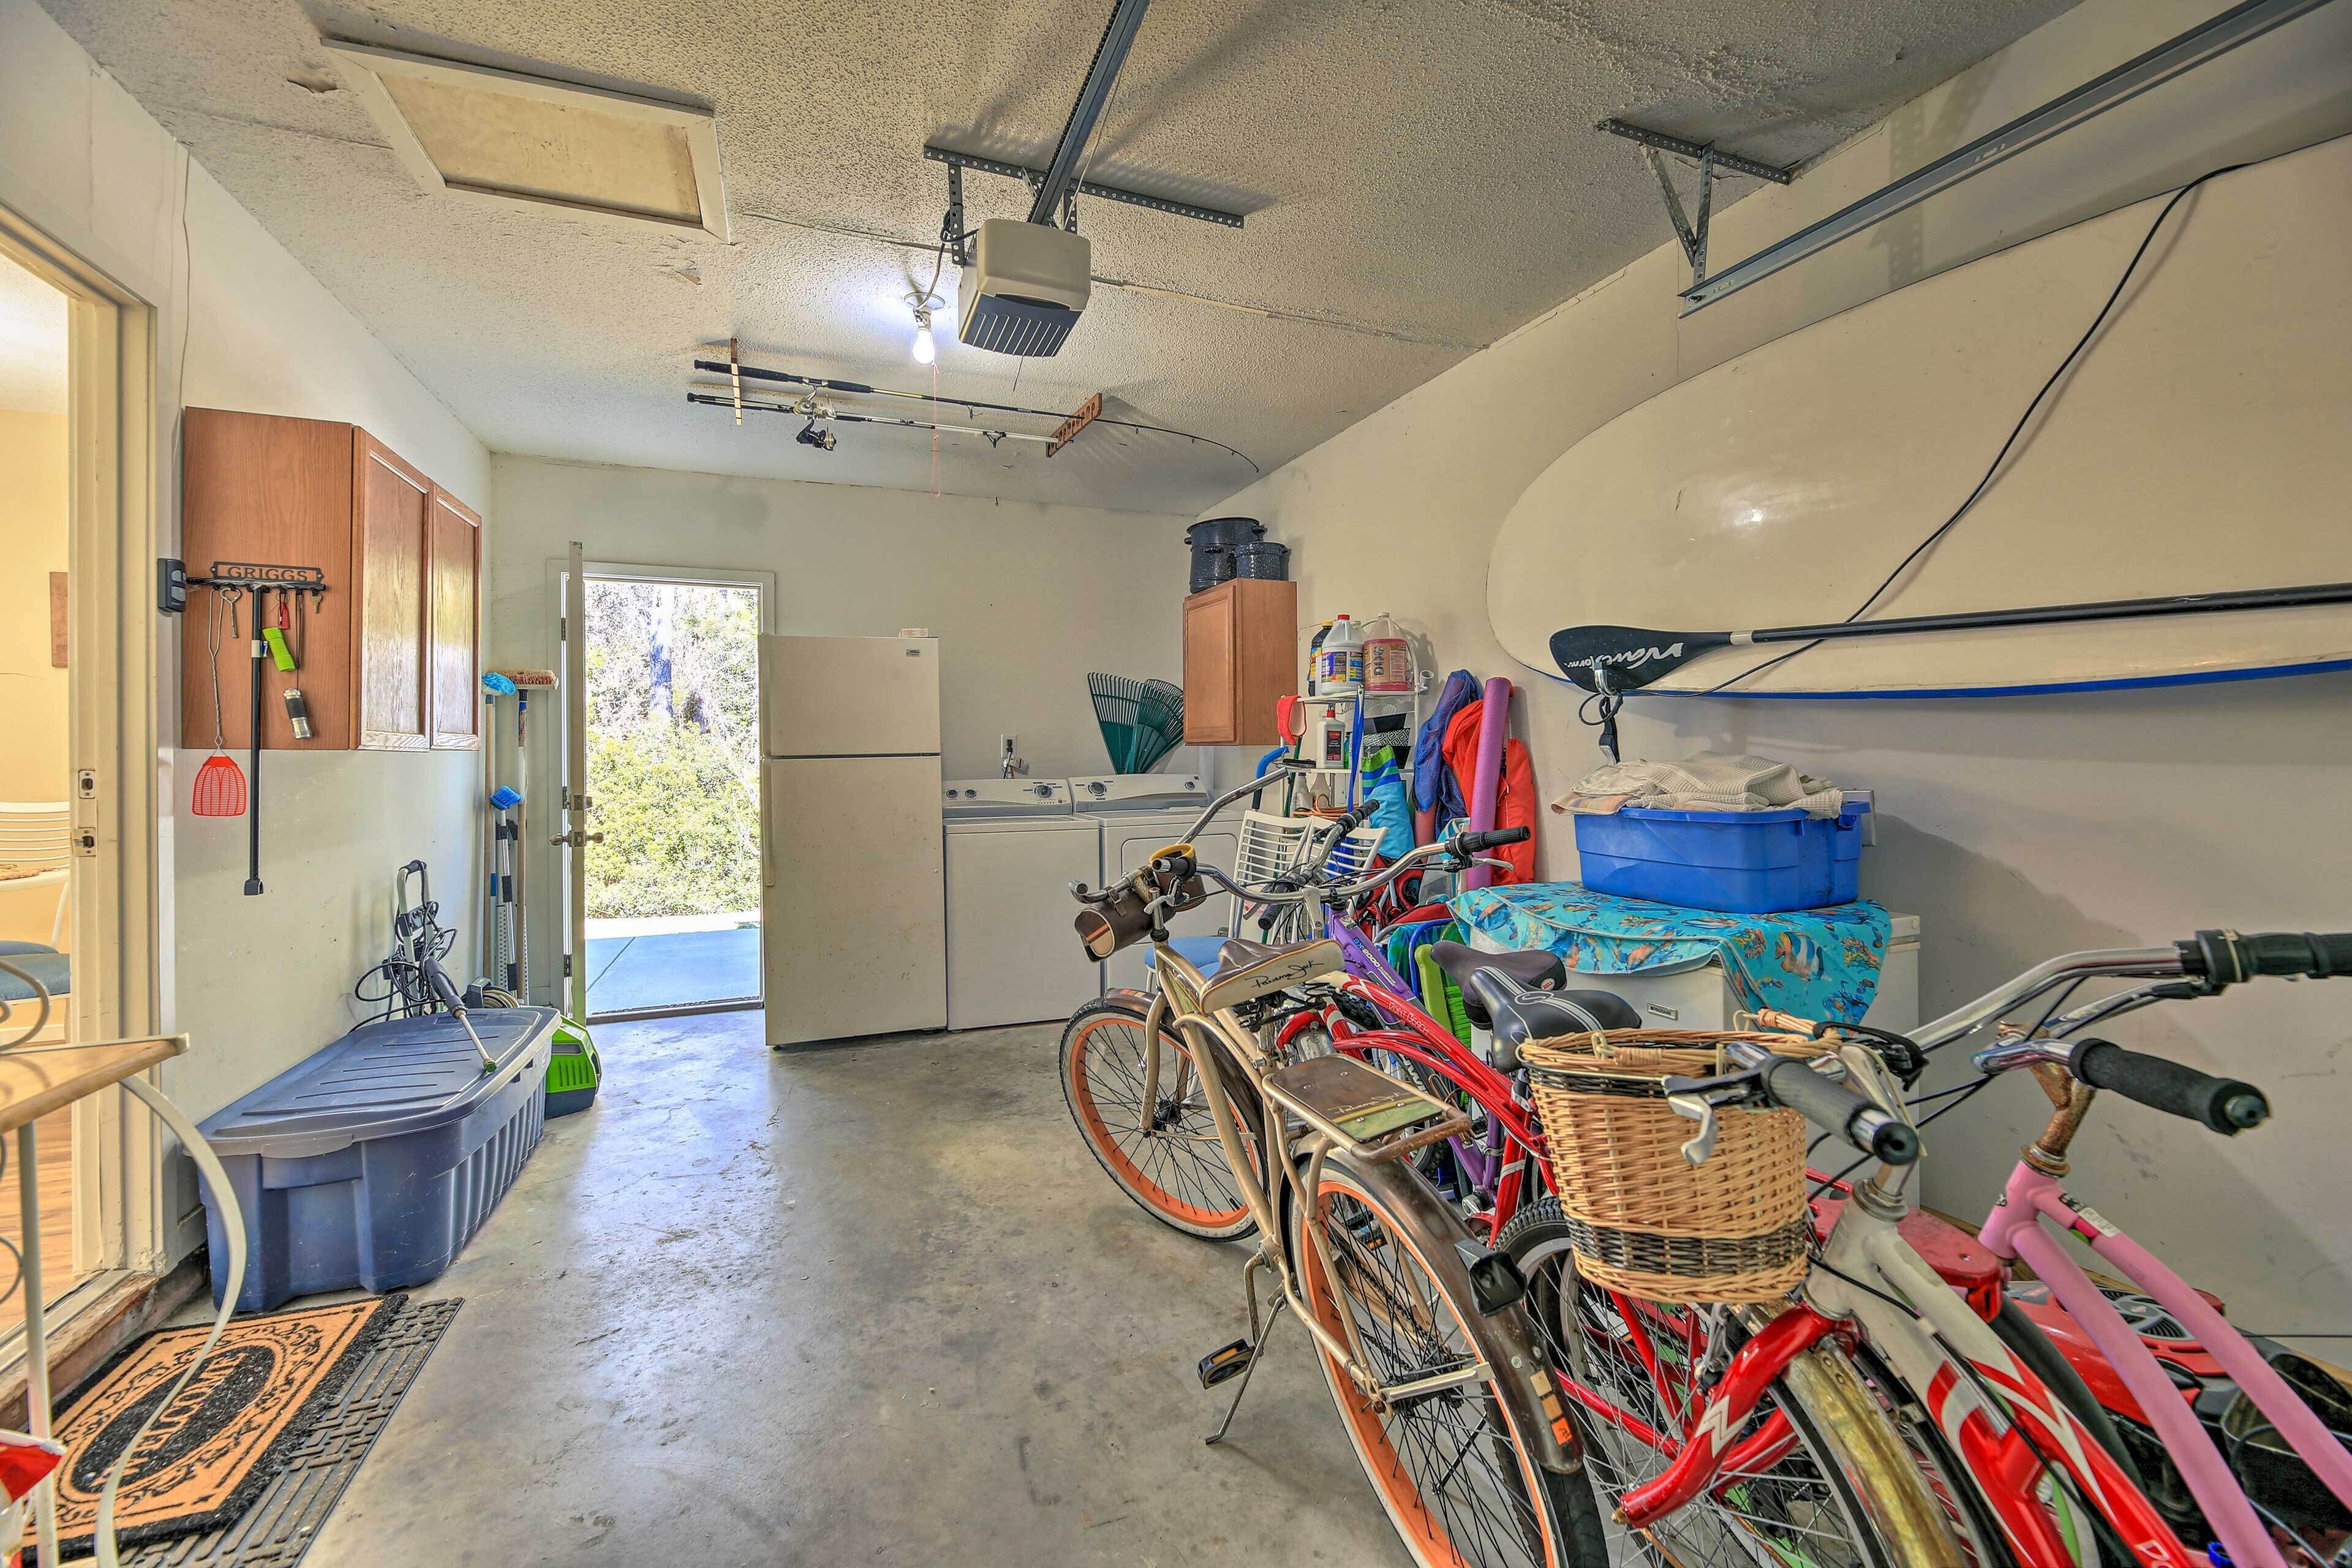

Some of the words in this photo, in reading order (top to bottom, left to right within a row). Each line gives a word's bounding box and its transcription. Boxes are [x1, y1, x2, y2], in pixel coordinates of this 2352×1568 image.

[227, 566, 308, 582] GRIGGS
[1245, 973, 1294, 989] Panama
[1287, 960, 1325, 980] Jack
[1542, 981, 1553, 990] BELL
